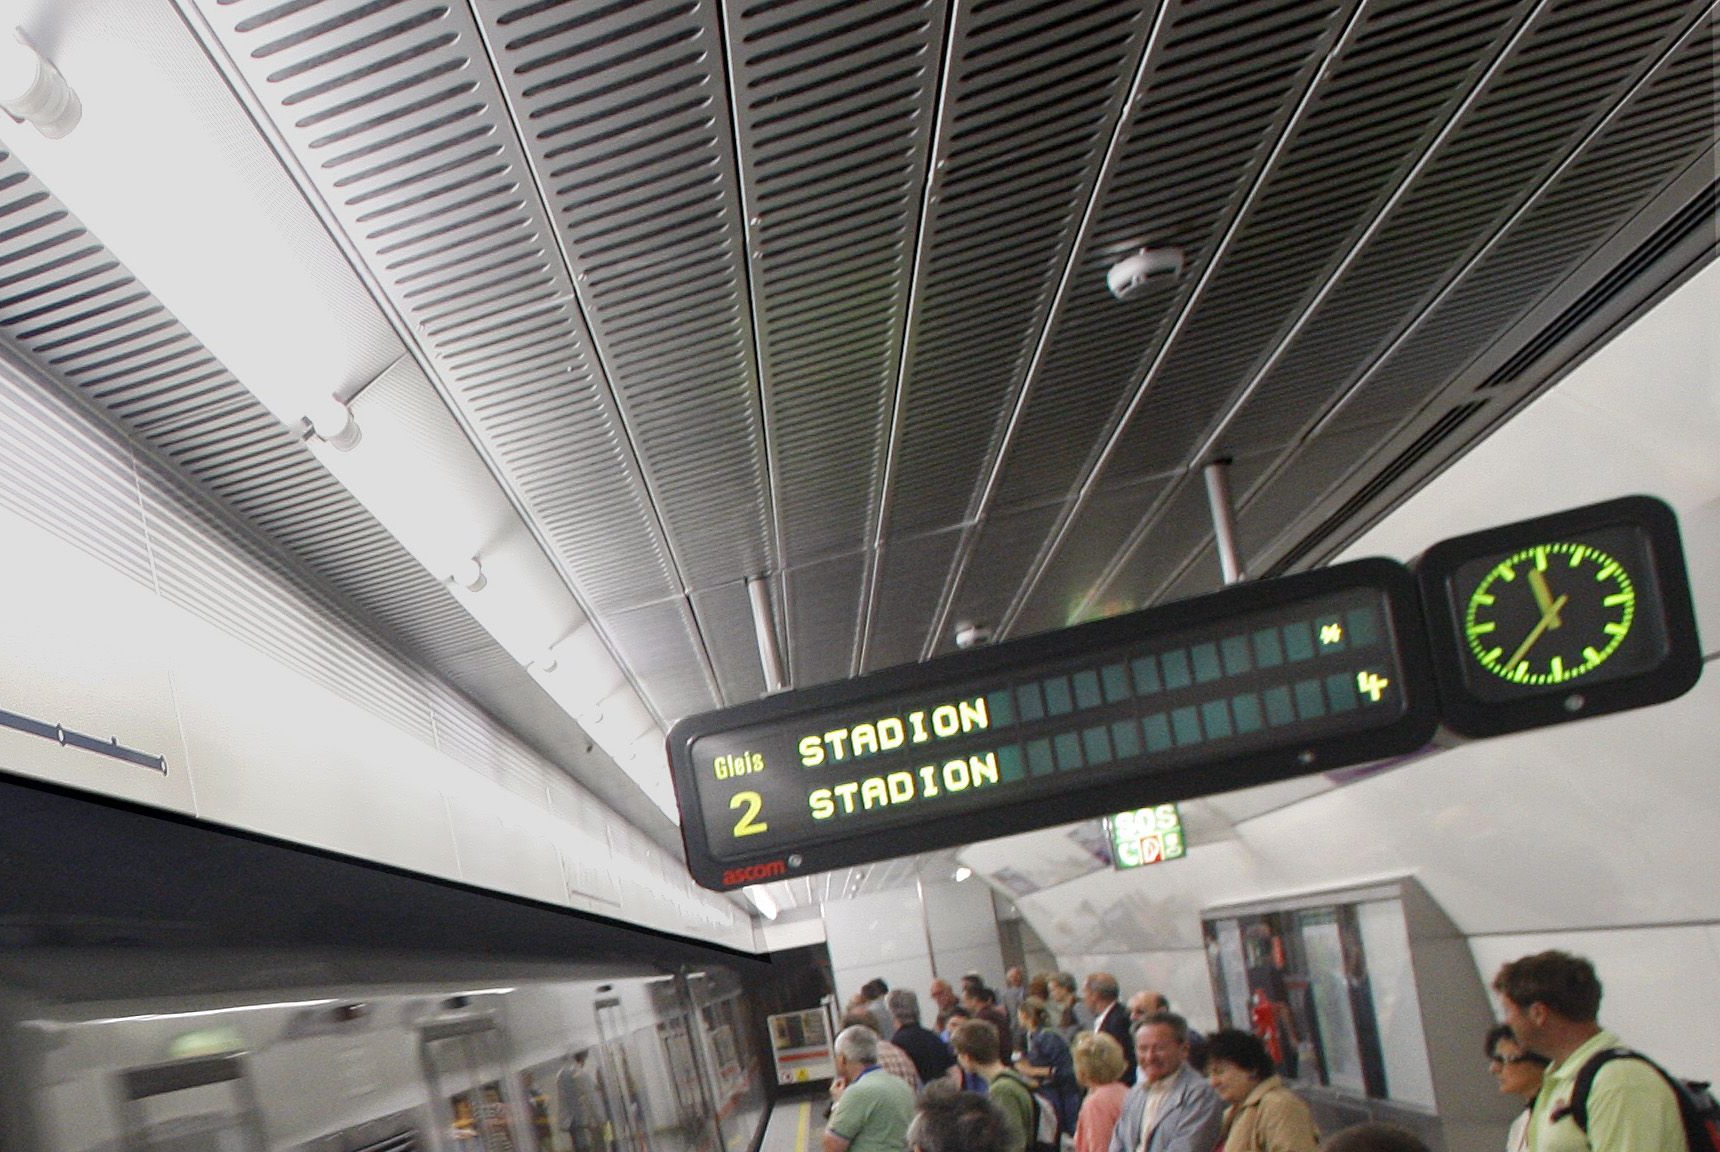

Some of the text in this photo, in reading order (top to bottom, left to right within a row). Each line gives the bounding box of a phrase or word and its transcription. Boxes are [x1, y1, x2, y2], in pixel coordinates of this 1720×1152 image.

[798, 697, 990, 767] STADION
[713, 751, 765, 780] Gleis
[809, 752, 999, 820] STADION
[729, 791, 769, 838] 2
[1115, 803, 1178, 838] SOS
[723, 859, 787, 886] ascom
